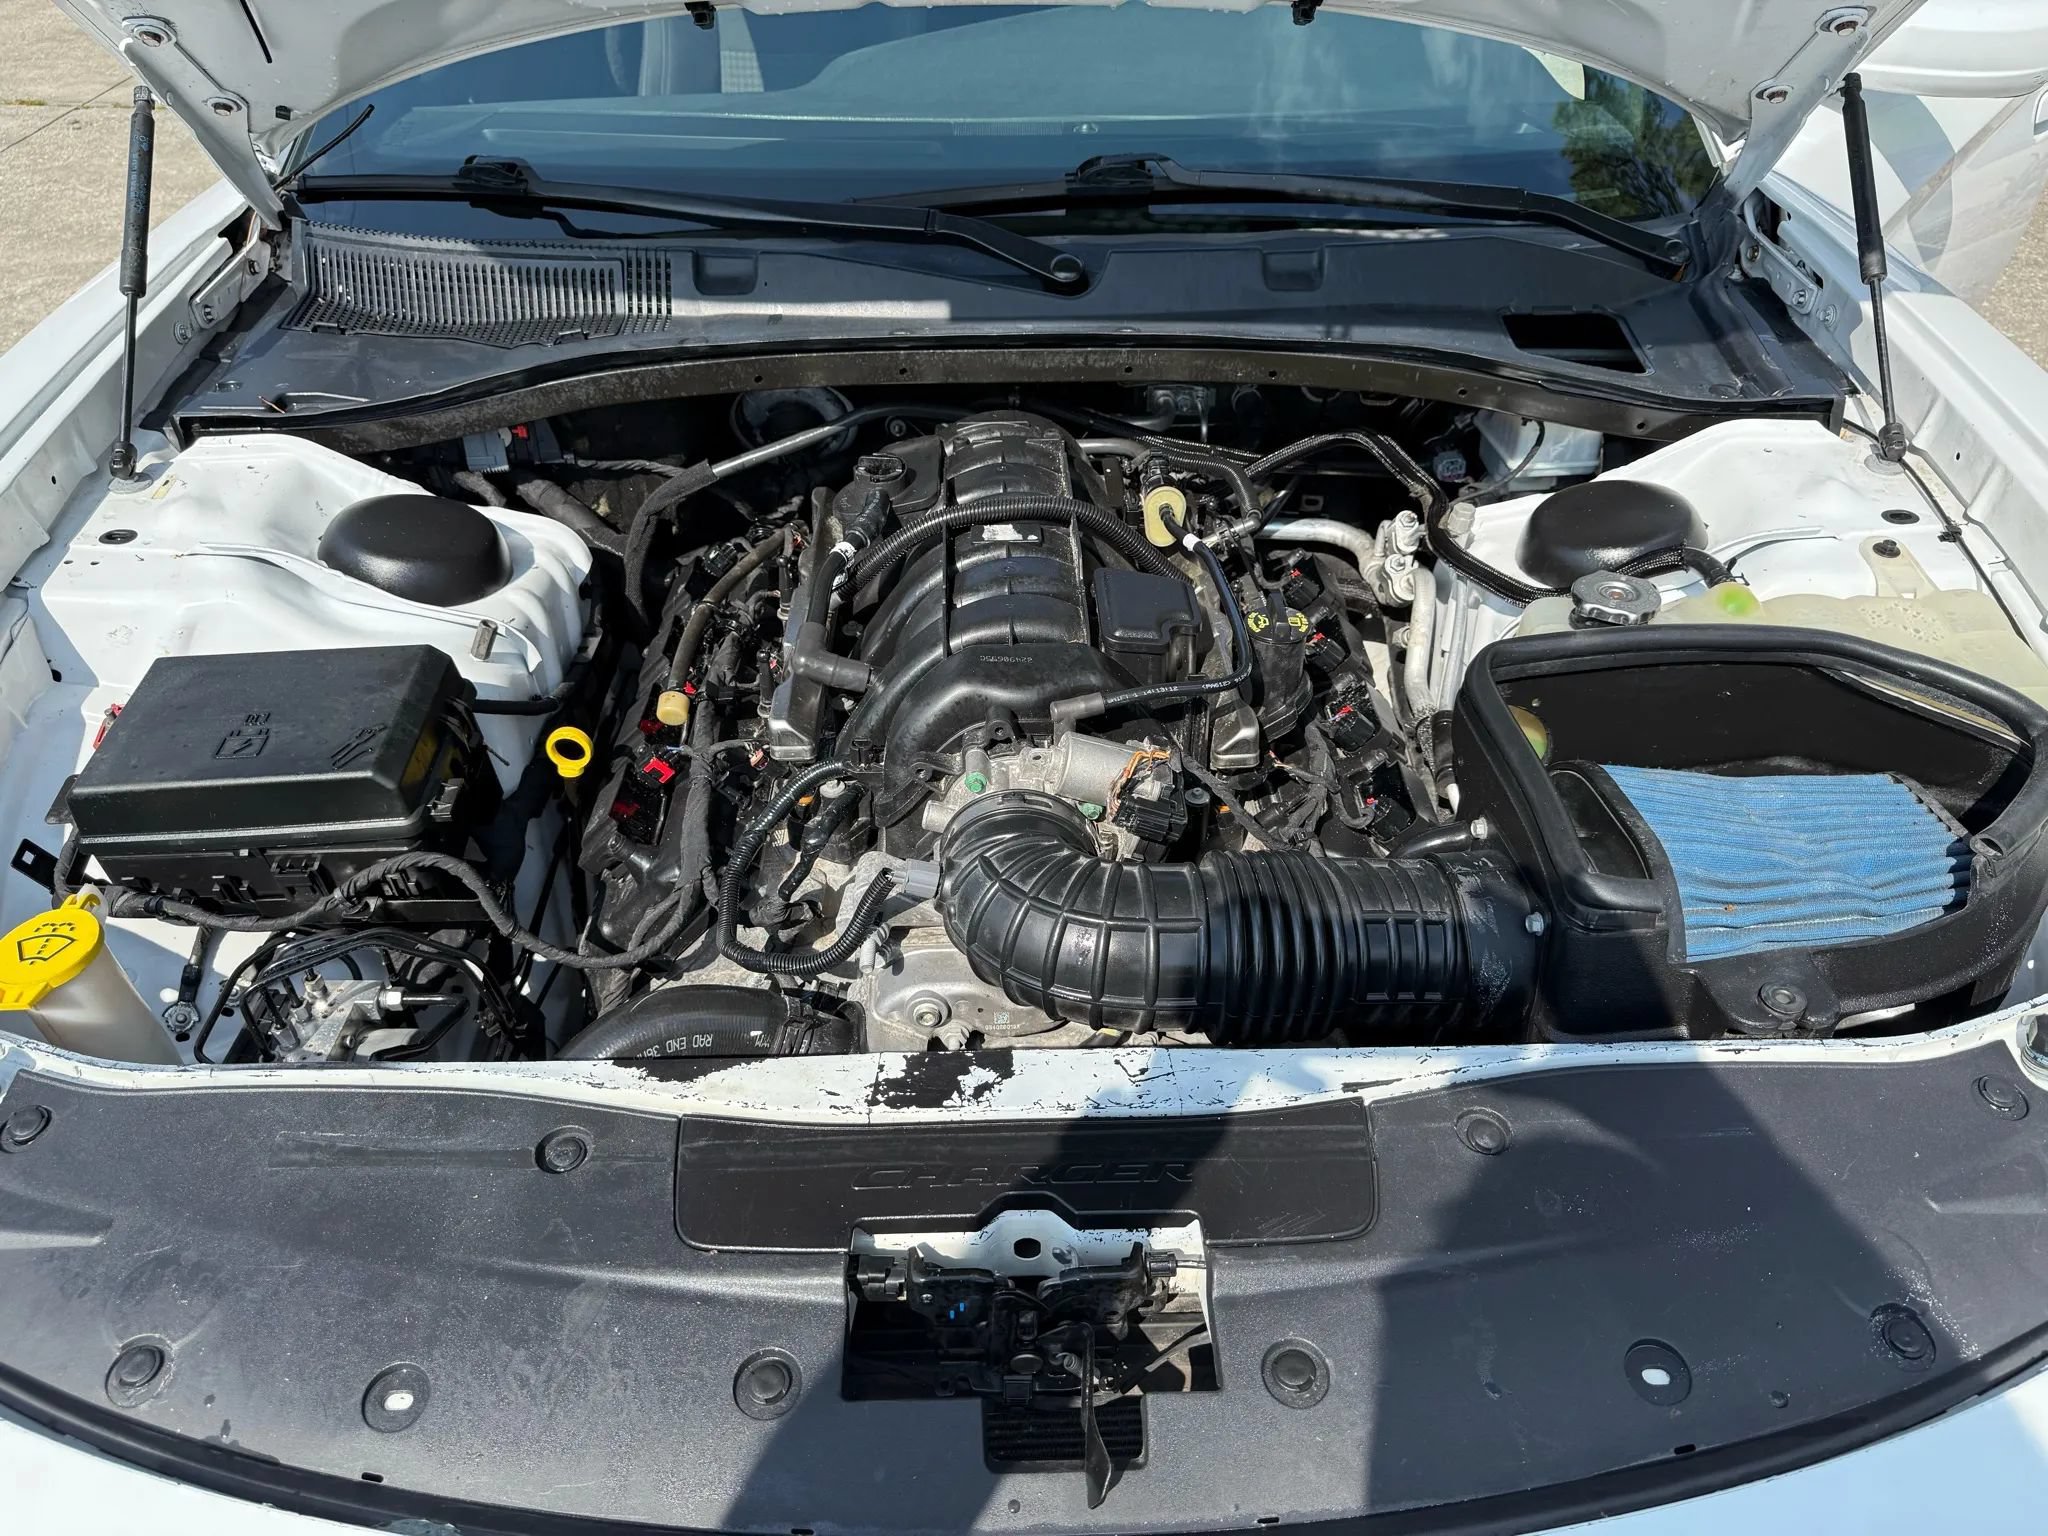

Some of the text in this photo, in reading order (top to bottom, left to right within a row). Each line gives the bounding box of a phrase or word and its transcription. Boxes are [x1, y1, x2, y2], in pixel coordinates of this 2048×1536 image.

[665, 1036, 687, 1053] END
[692, 1033, 713, 1048] RAD
[851, 1163, 1192, 1191] CHARGER
